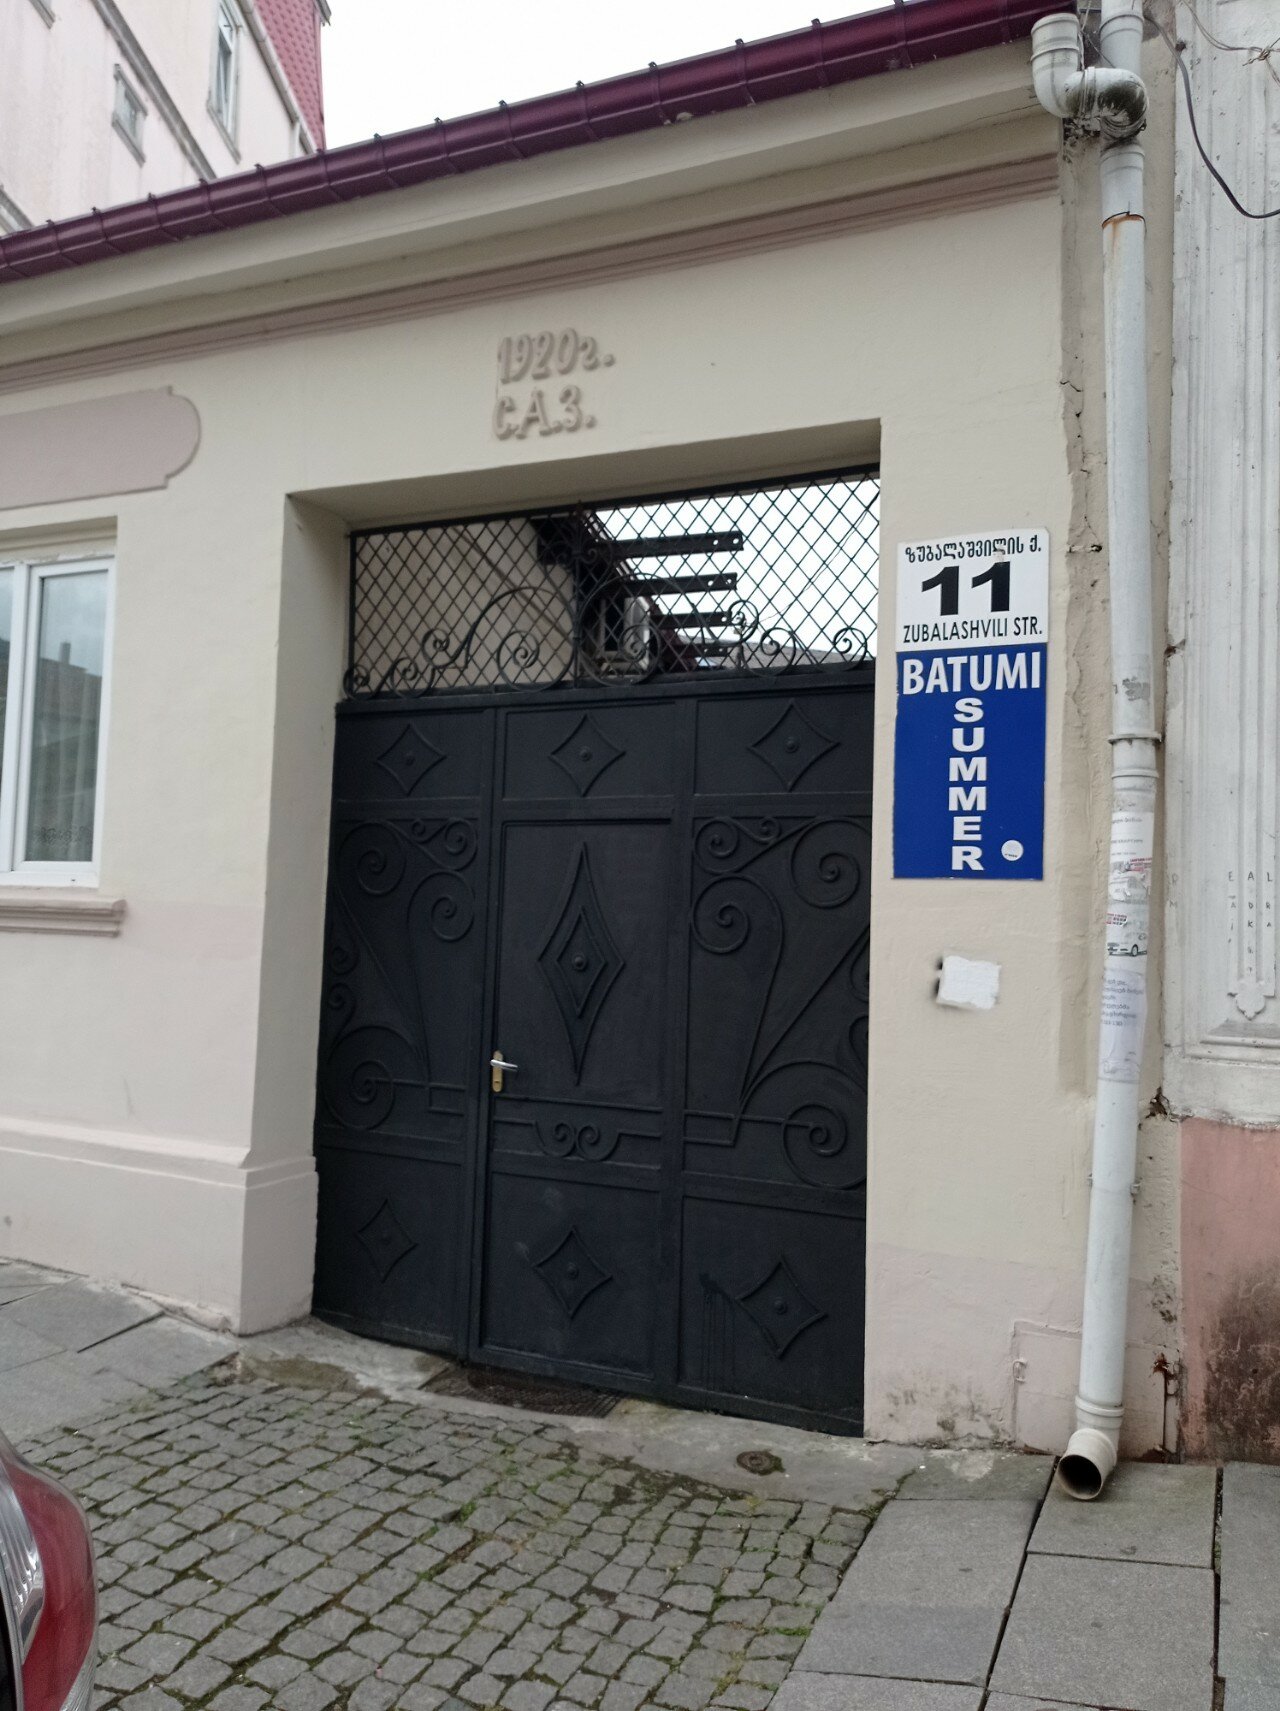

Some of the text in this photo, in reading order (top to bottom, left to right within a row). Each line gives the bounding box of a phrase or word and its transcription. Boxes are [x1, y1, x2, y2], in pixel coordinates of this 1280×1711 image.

[905, 534, 1042, 563] ზუბალაშვილის ქ.
[921, 561, 1011, 616] 11
[903, 616, 1042, 643] ZUBALASHVILI STR.
[902, 651, 1041, 695] BATUMI
[948, 697, 988, 871] SUMMER
